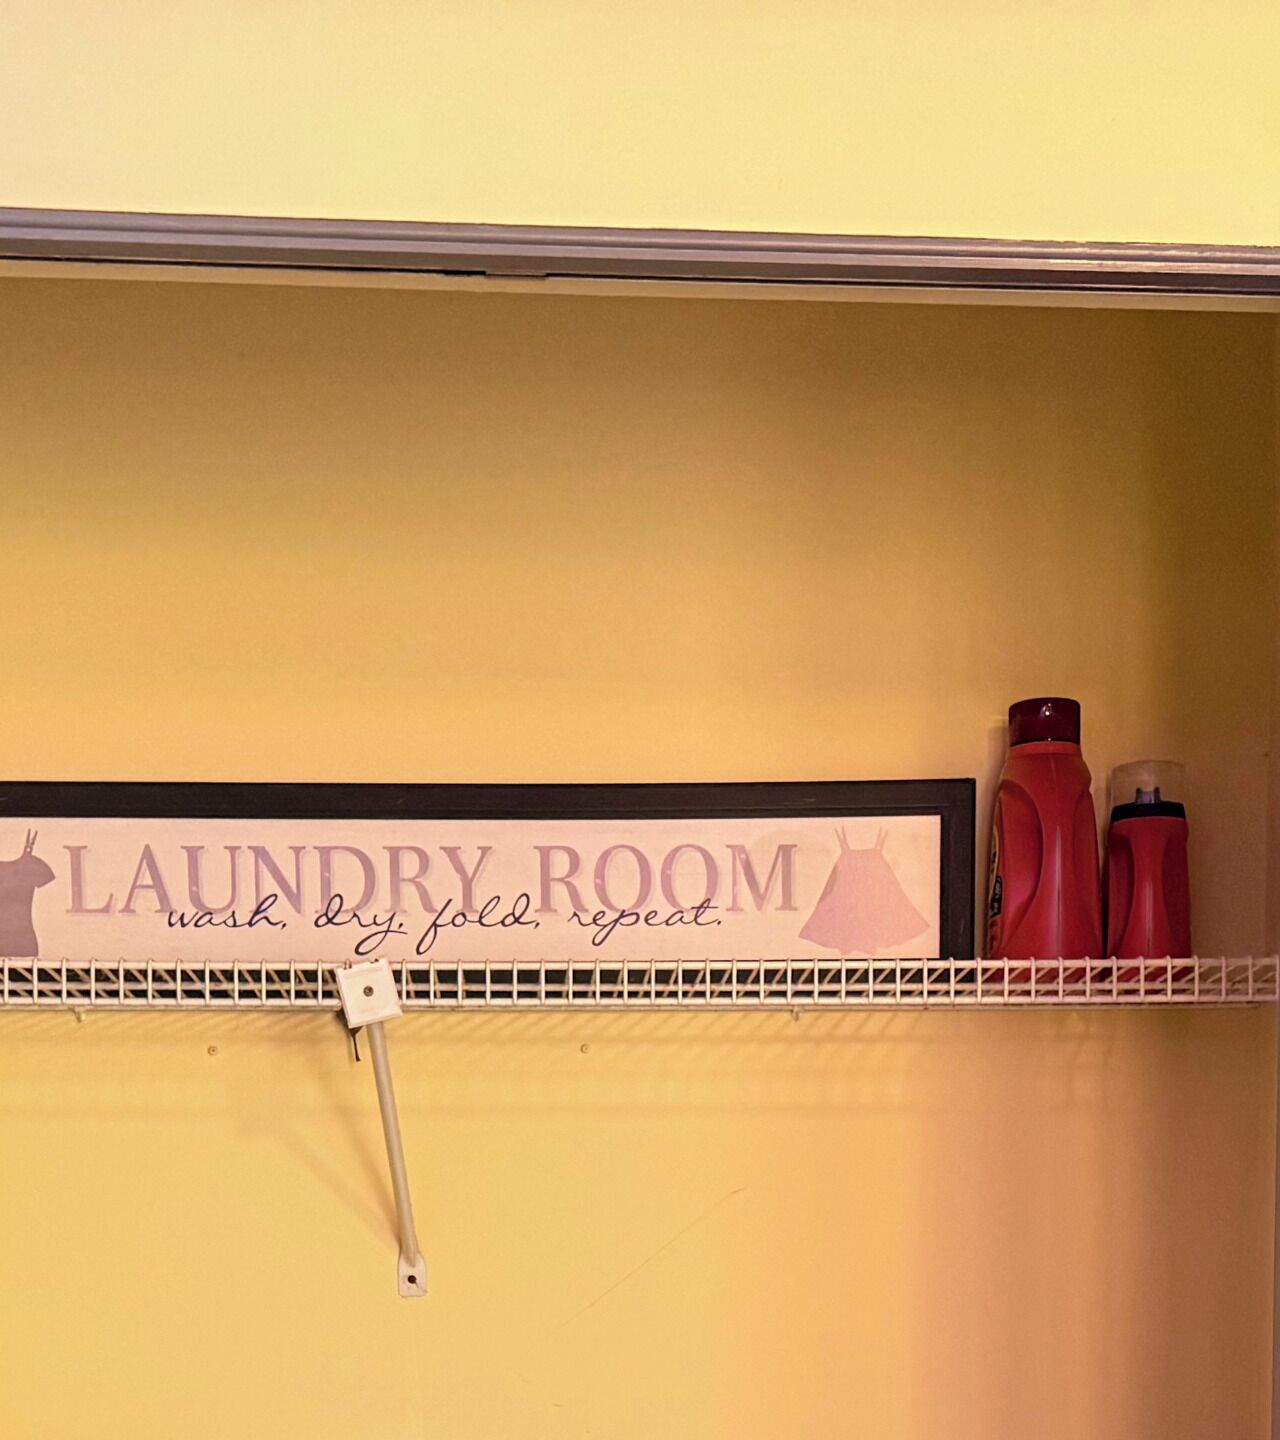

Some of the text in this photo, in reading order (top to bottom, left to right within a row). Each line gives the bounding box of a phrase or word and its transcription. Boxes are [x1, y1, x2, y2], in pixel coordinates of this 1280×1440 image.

[63, 843, 798, 915] LAUNDRY ROOM
[167, 893, 288, 930] wash,
[415, 893, 541, 956] fold,
[568, 897, 722, 947] repeat.
